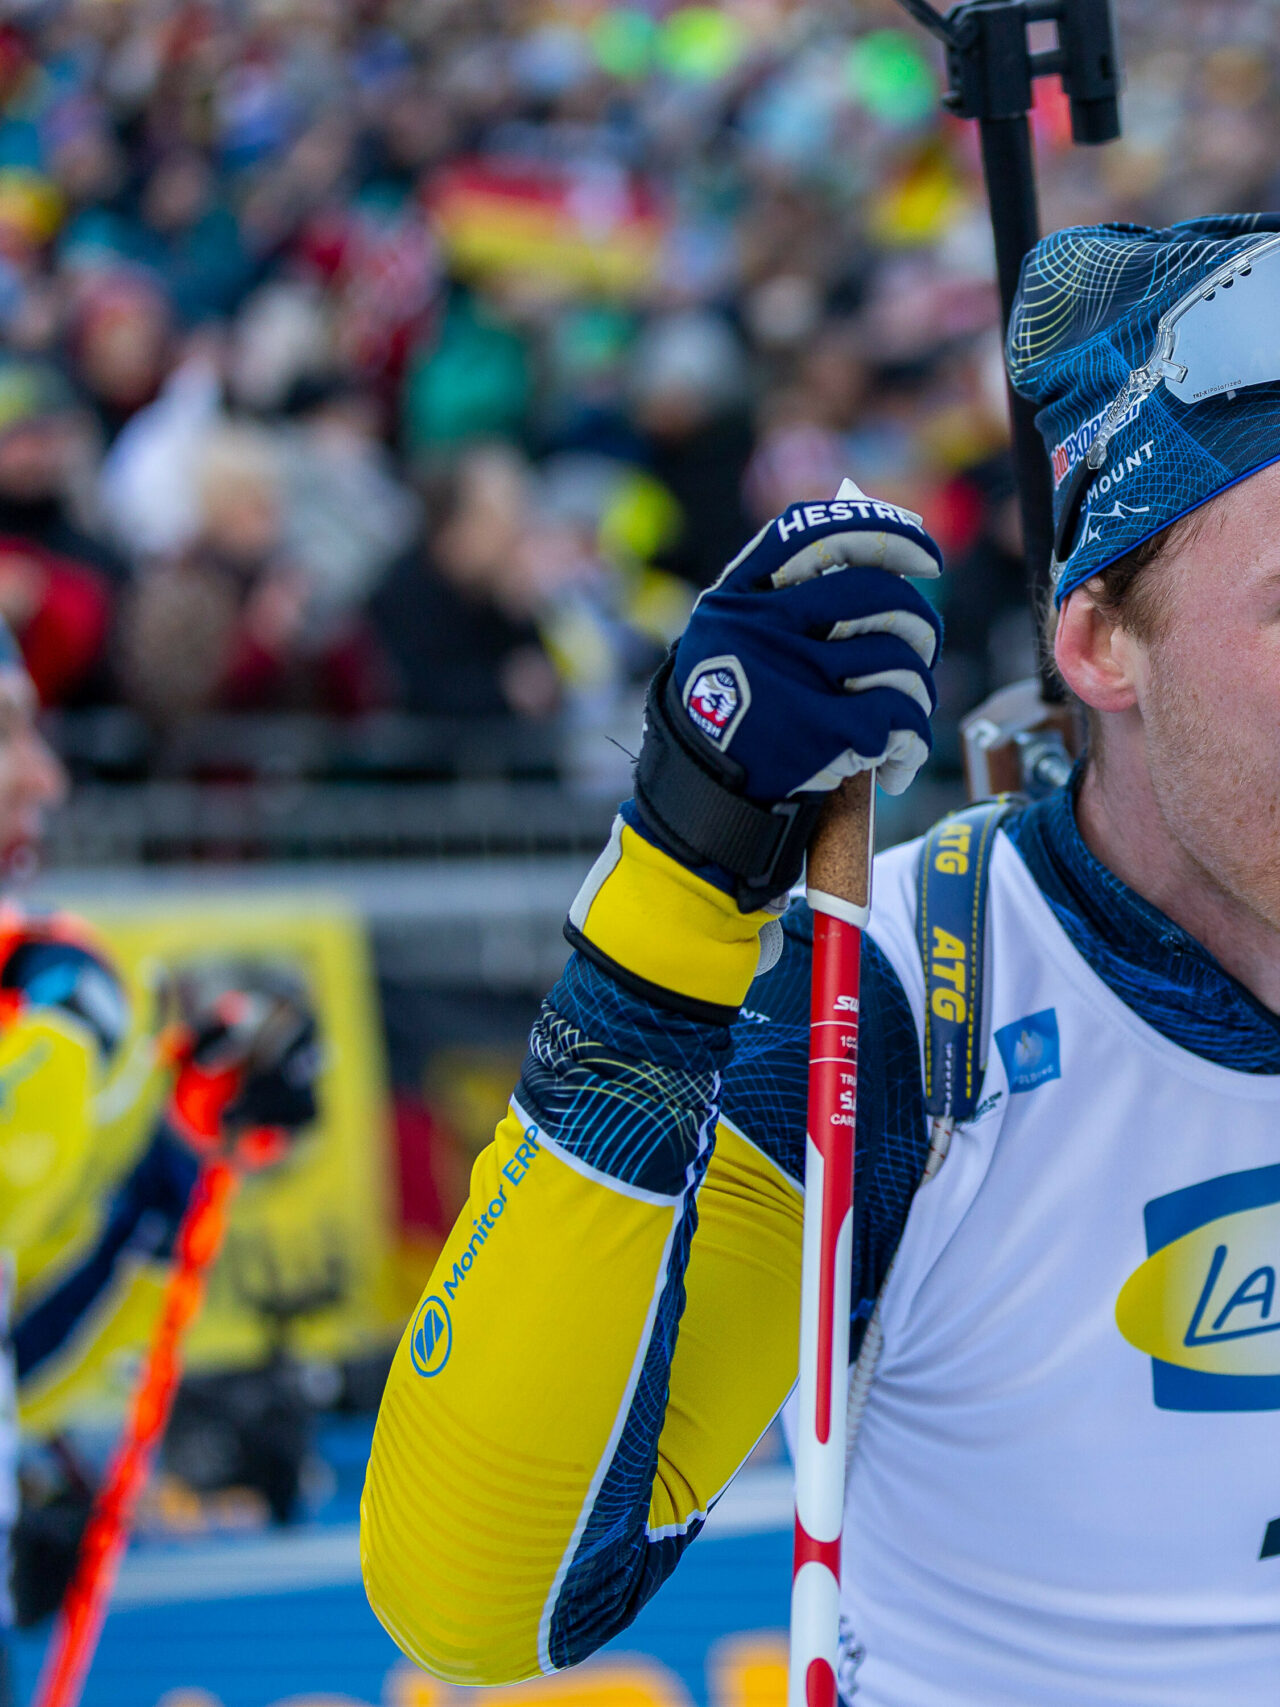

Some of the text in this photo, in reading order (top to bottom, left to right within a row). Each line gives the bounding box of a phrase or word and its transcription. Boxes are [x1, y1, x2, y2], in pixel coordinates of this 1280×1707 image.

[934, 823, 972, 875] ATG
[931, 926, 967, 1024] ATG
[443, 1124, 540, 1300] Monitor ERP
